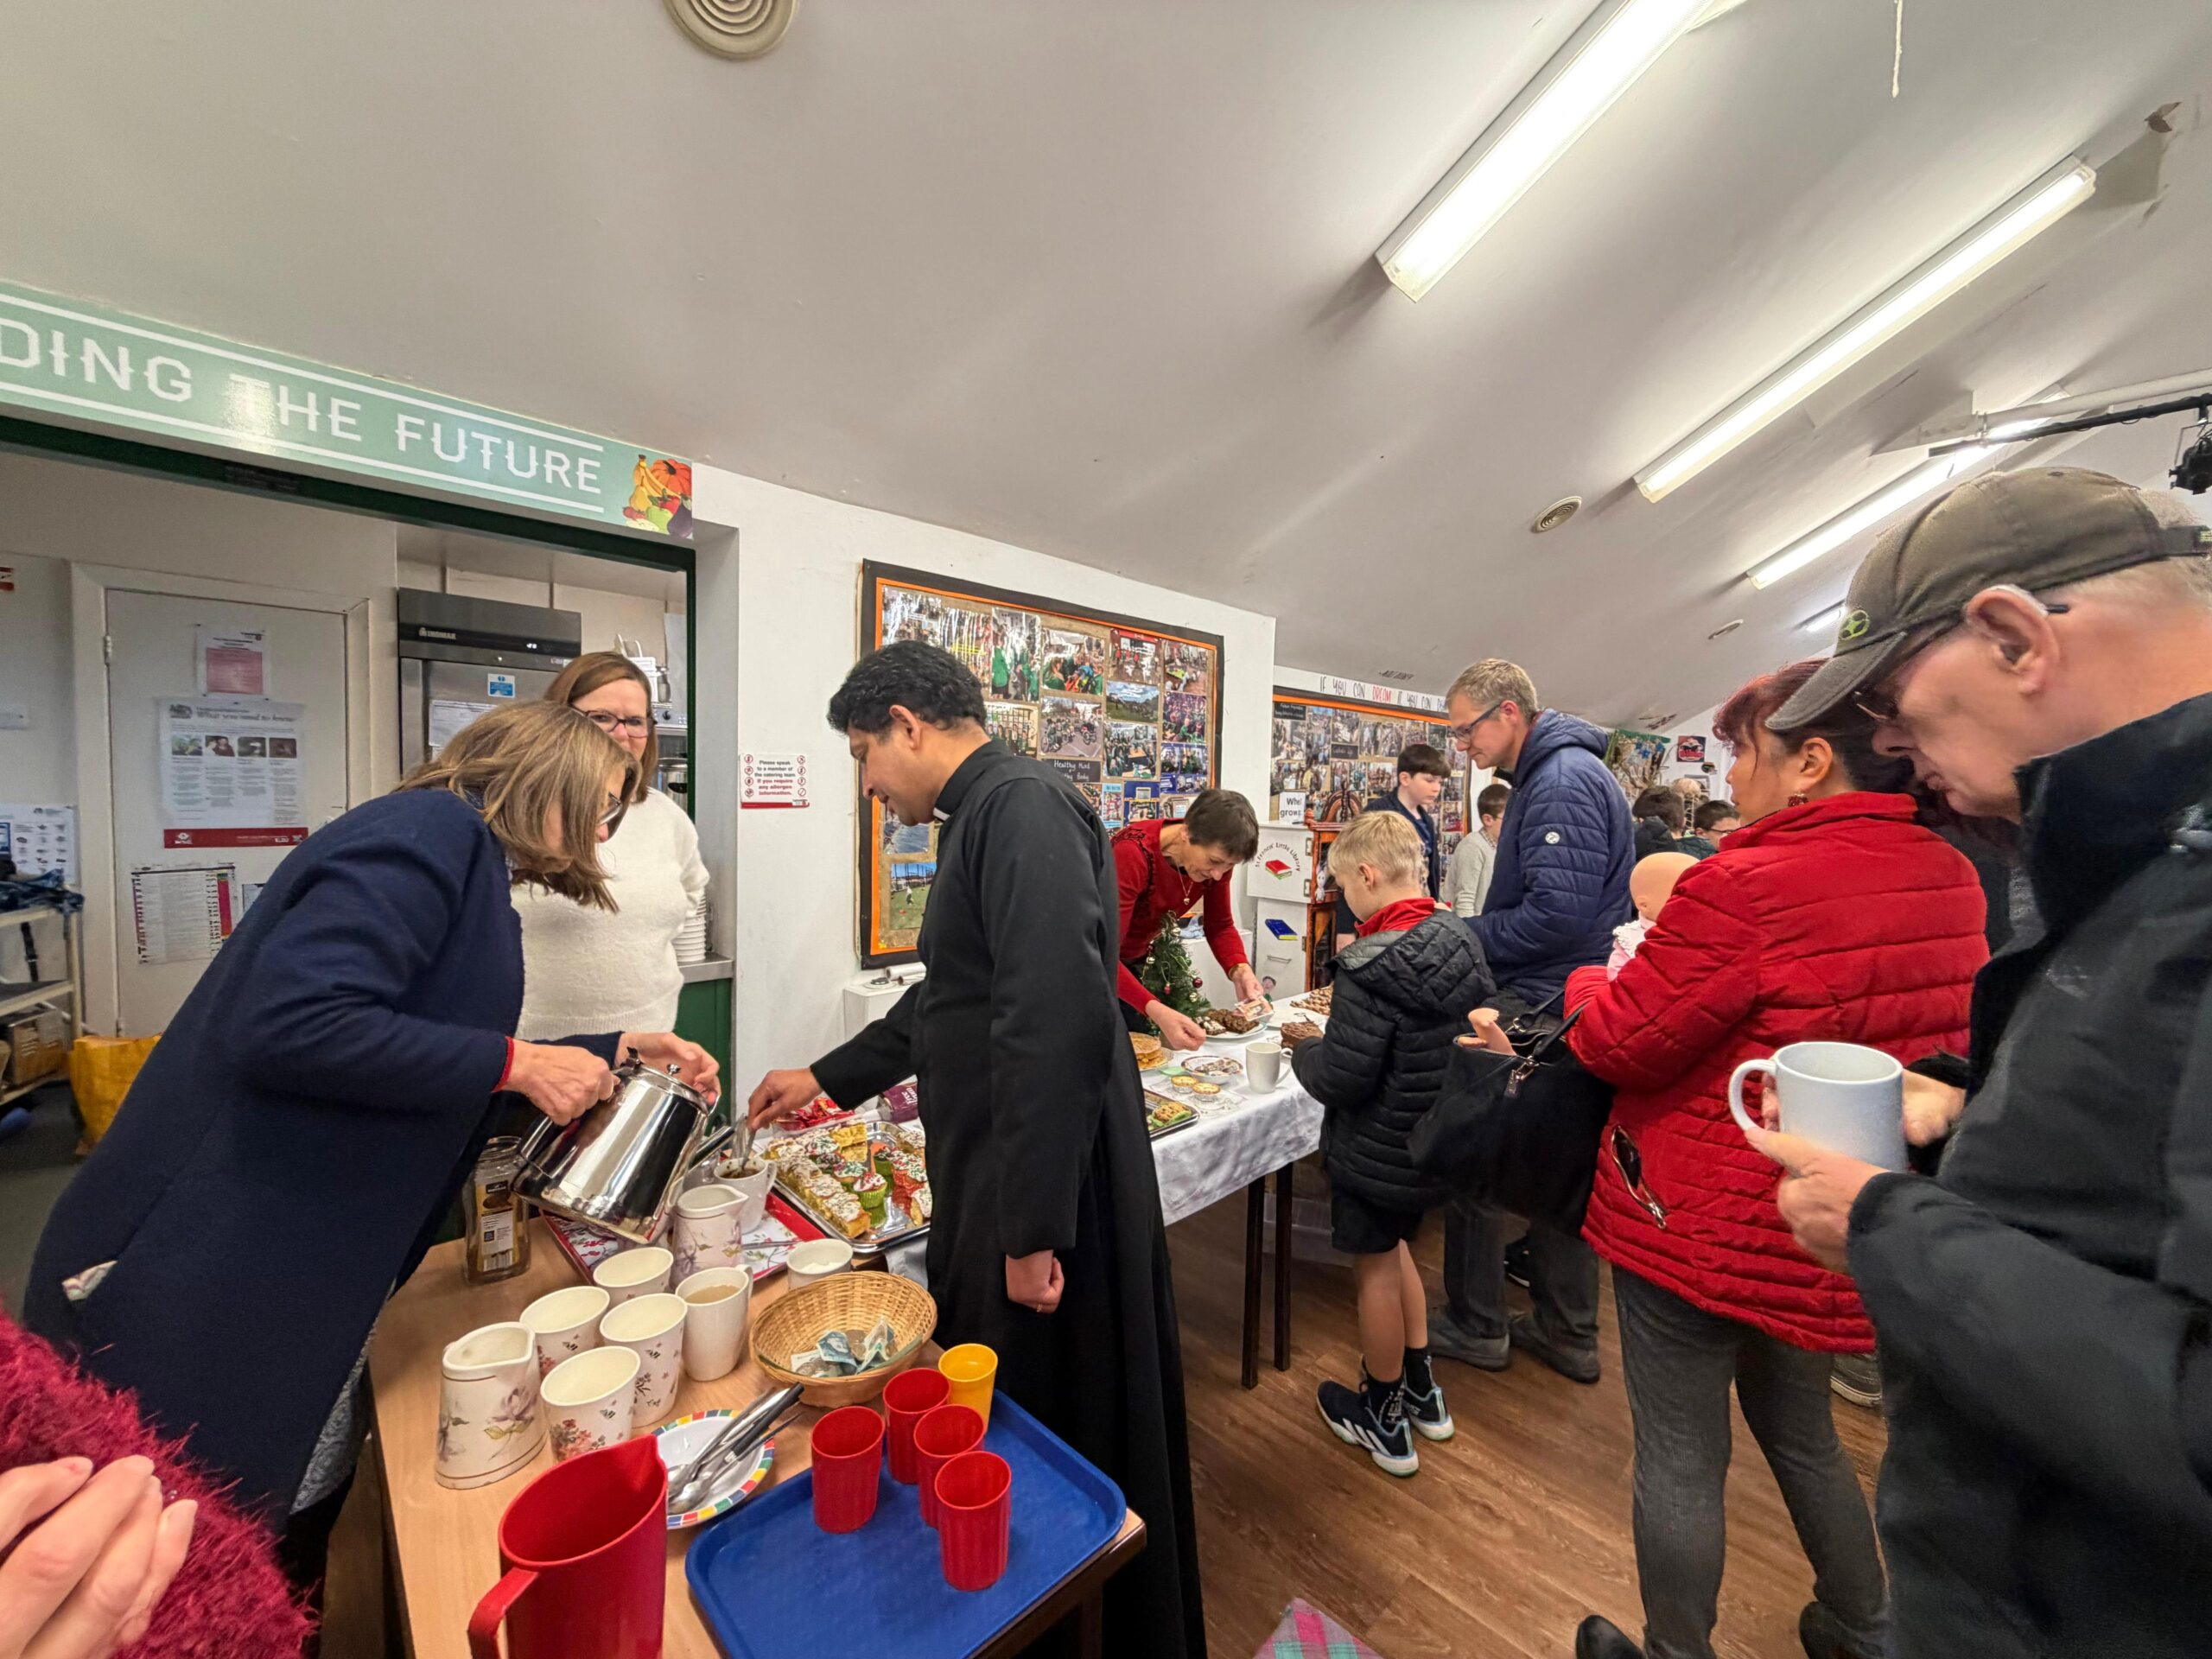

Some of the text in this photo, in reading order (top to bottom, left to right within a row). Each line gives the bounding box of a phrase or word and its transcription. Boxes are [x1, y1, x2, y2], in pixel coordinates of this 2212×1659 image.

[229, 372, 362, 442] THE
[395, 413, 602, 495] FUTURE
[1319, 676, 1326, 692] IF
[1332, 678, 1347, 696] YOU
